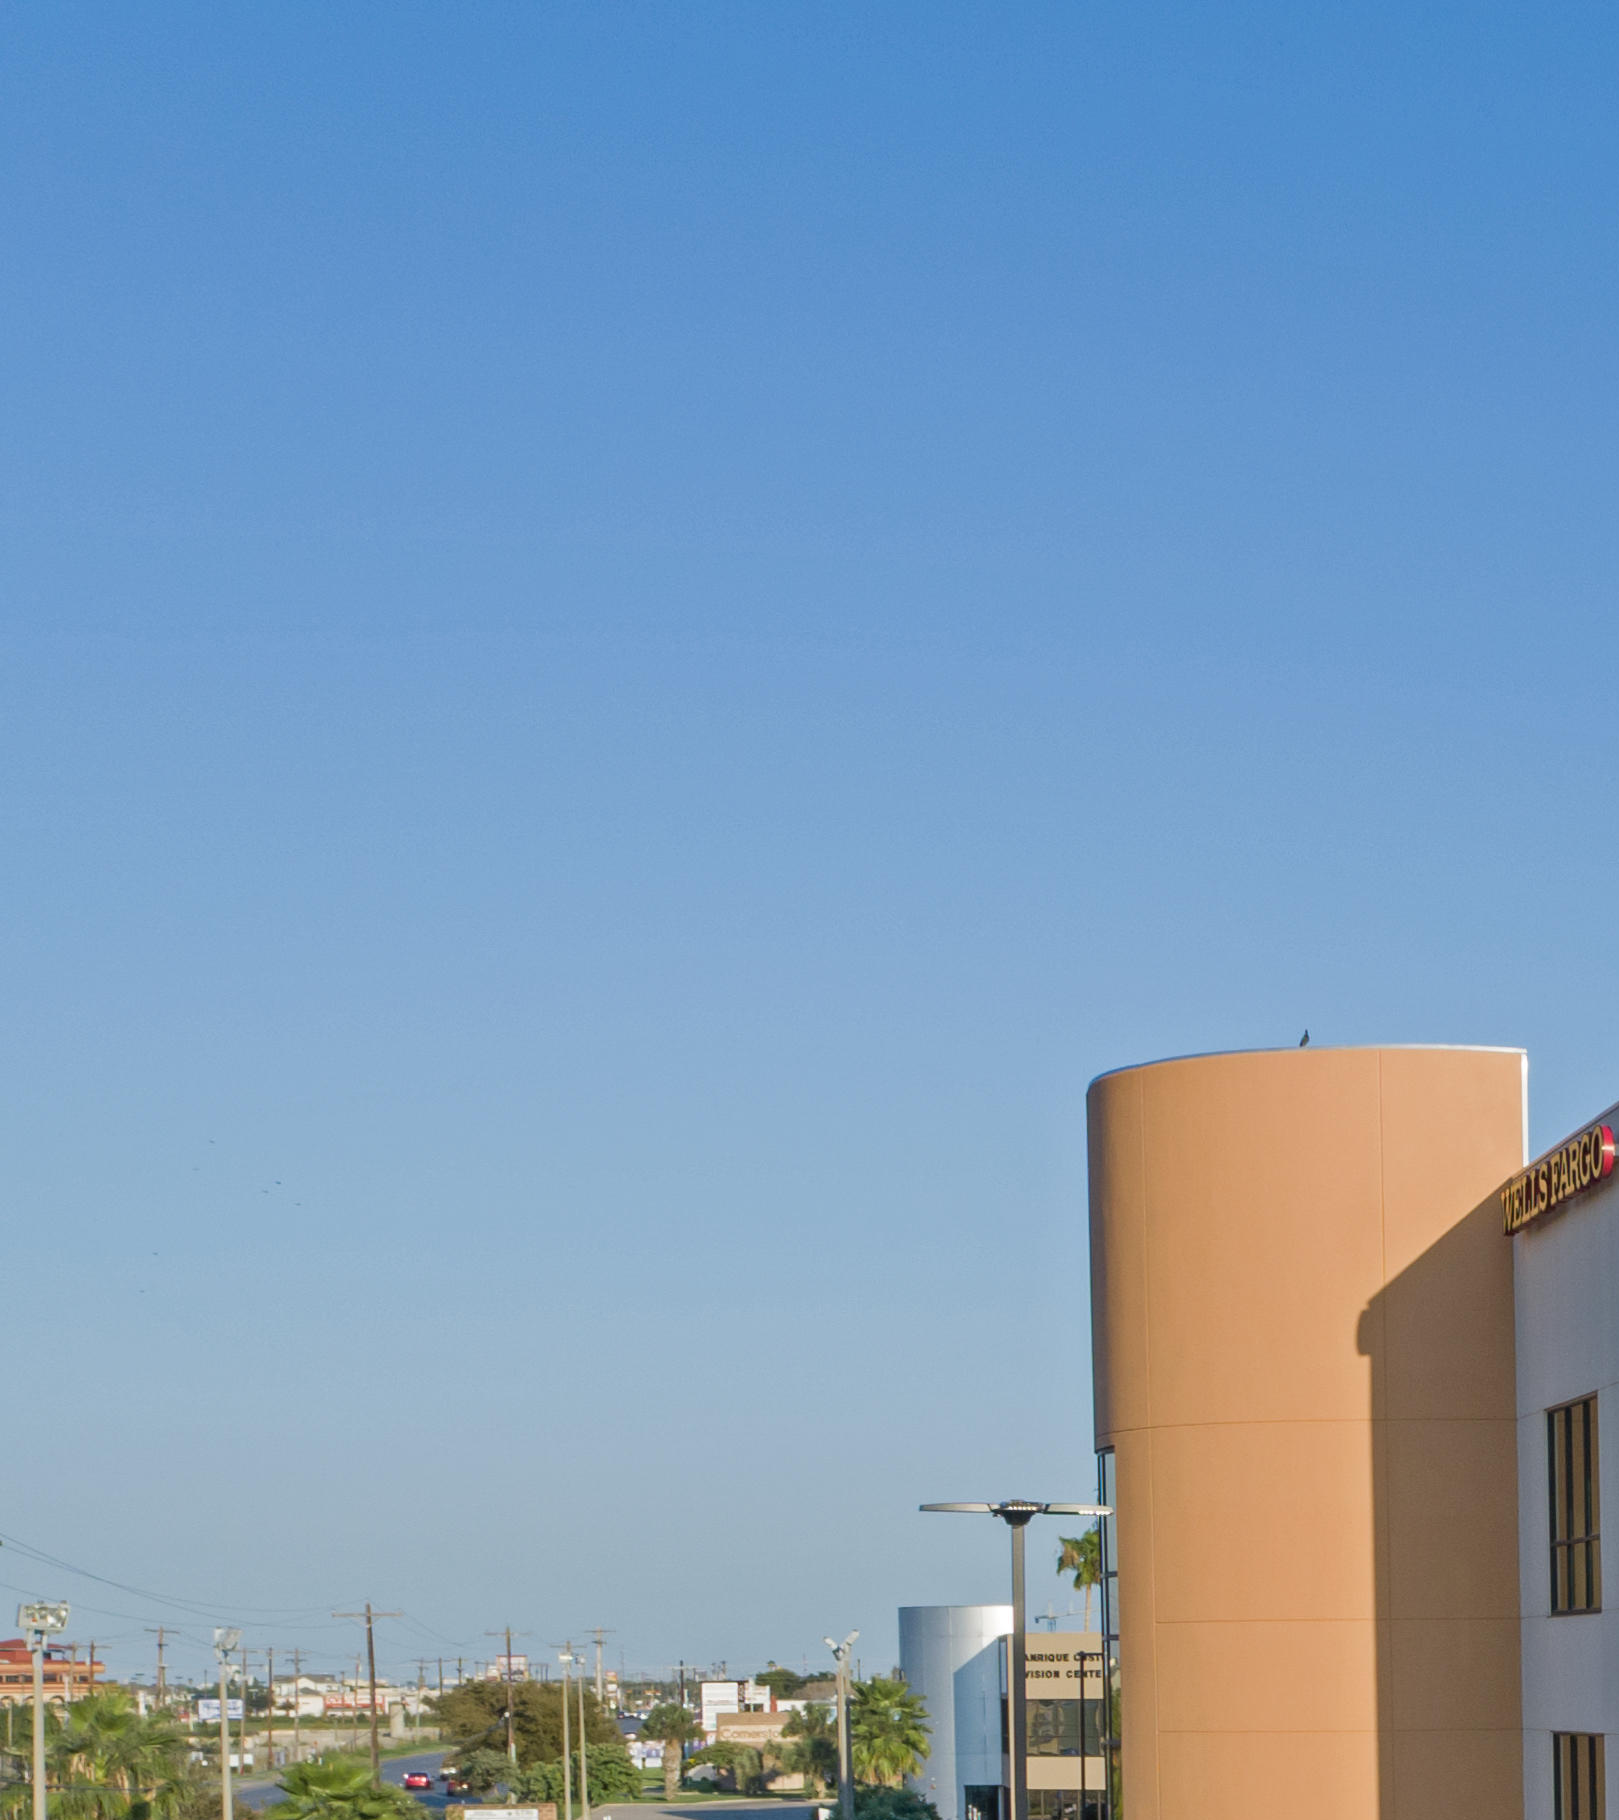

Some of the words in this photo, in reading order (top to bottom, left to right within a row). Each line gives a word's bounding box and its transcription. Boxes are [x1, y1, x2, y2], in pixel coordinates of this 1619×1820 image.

[1501, 1162, 1549, 1235] WELLS
[1551, 1125, 1604, 1206] FARGO
[1024, 1653, 1070, 1662] ANRIQUE
[1065, 1669, 1103, 1679] CENTE
